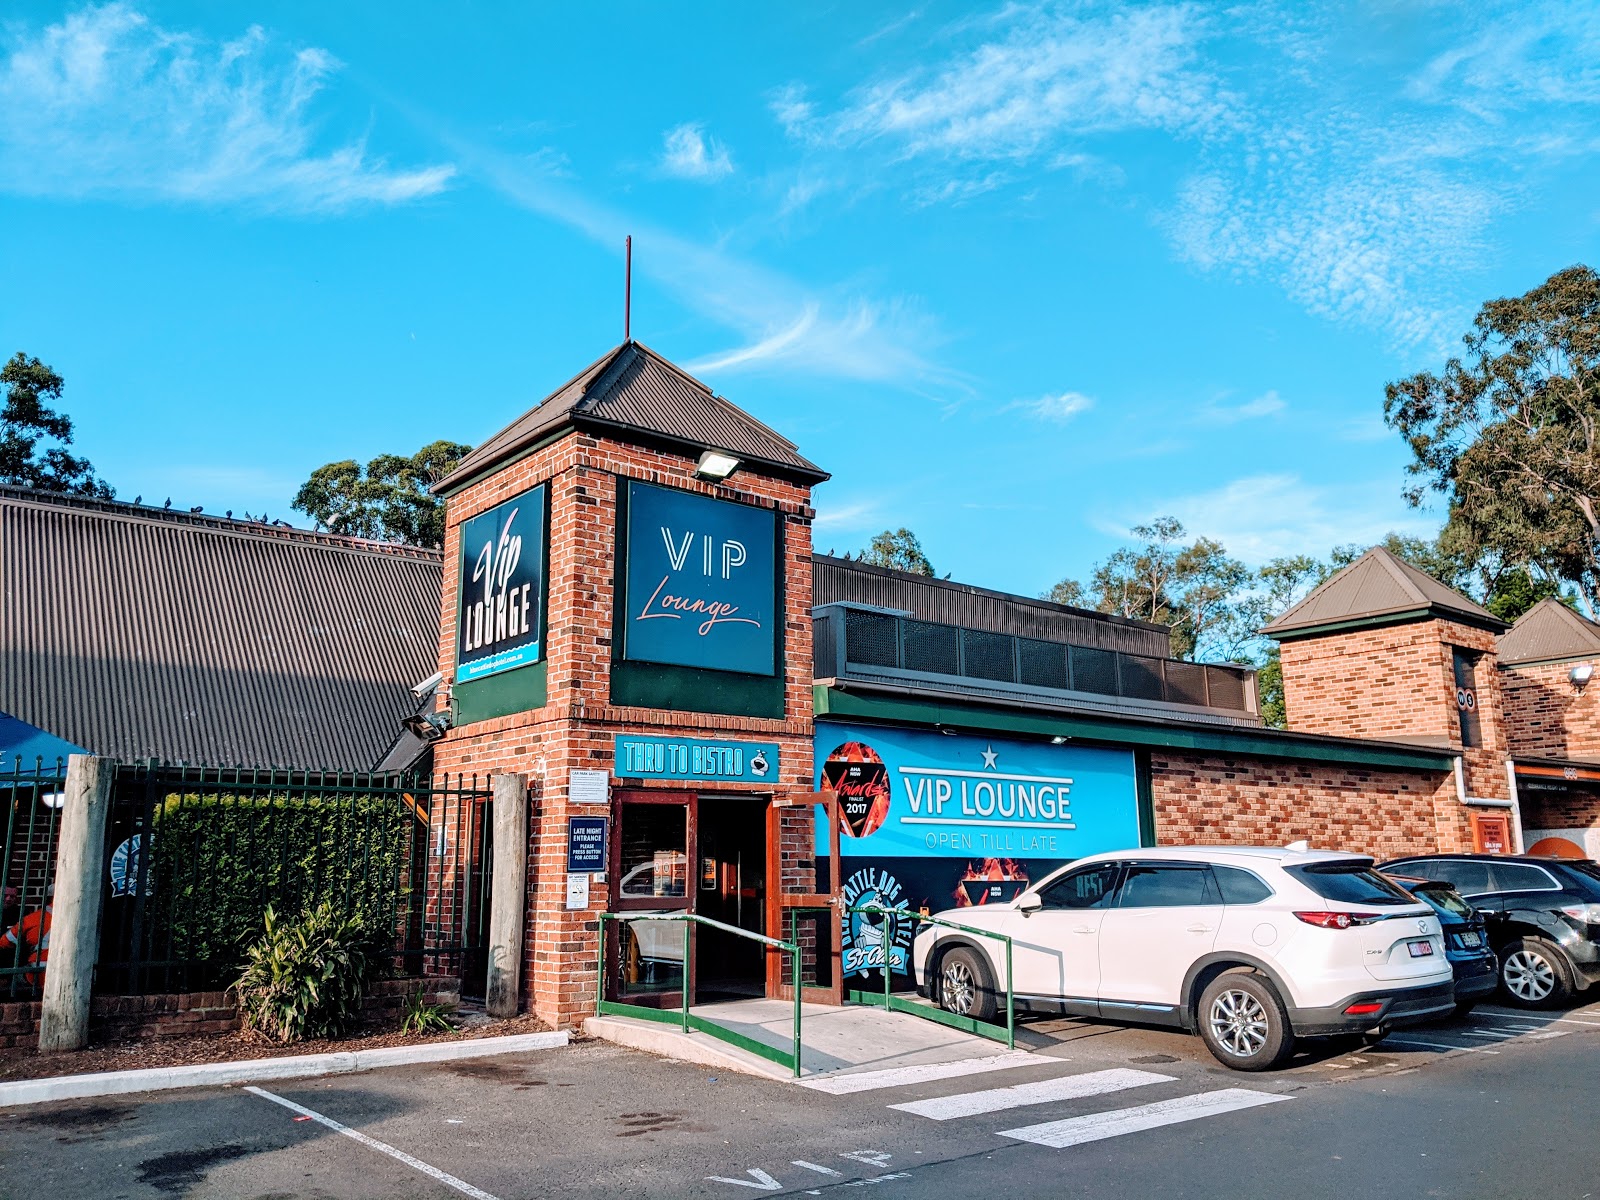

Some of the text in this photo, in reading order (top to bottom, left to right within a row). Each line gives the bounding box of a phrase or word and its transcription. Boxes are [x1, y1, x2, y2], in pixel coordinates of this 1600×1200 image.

[660, 526, 747, 580] VIP
[465, 582, 531, 652] LOUNGE
[636, 575, 761, 636] Lounge
[623, 742, 744, 776] THRU TO BISTRO
[846, 803, 867, 814] 2017
[903, 777, 1073, 820] VIP LOUNGE
[573, 827, 602, 835] LATE NIGHT
[573, 834, 602, 842] ENTRANCE
[925, 832, 1058, 851] OPEN TILL LATE
[879, 869, 903, 901] DOG
[845, 945, 902, 970] St Clir
